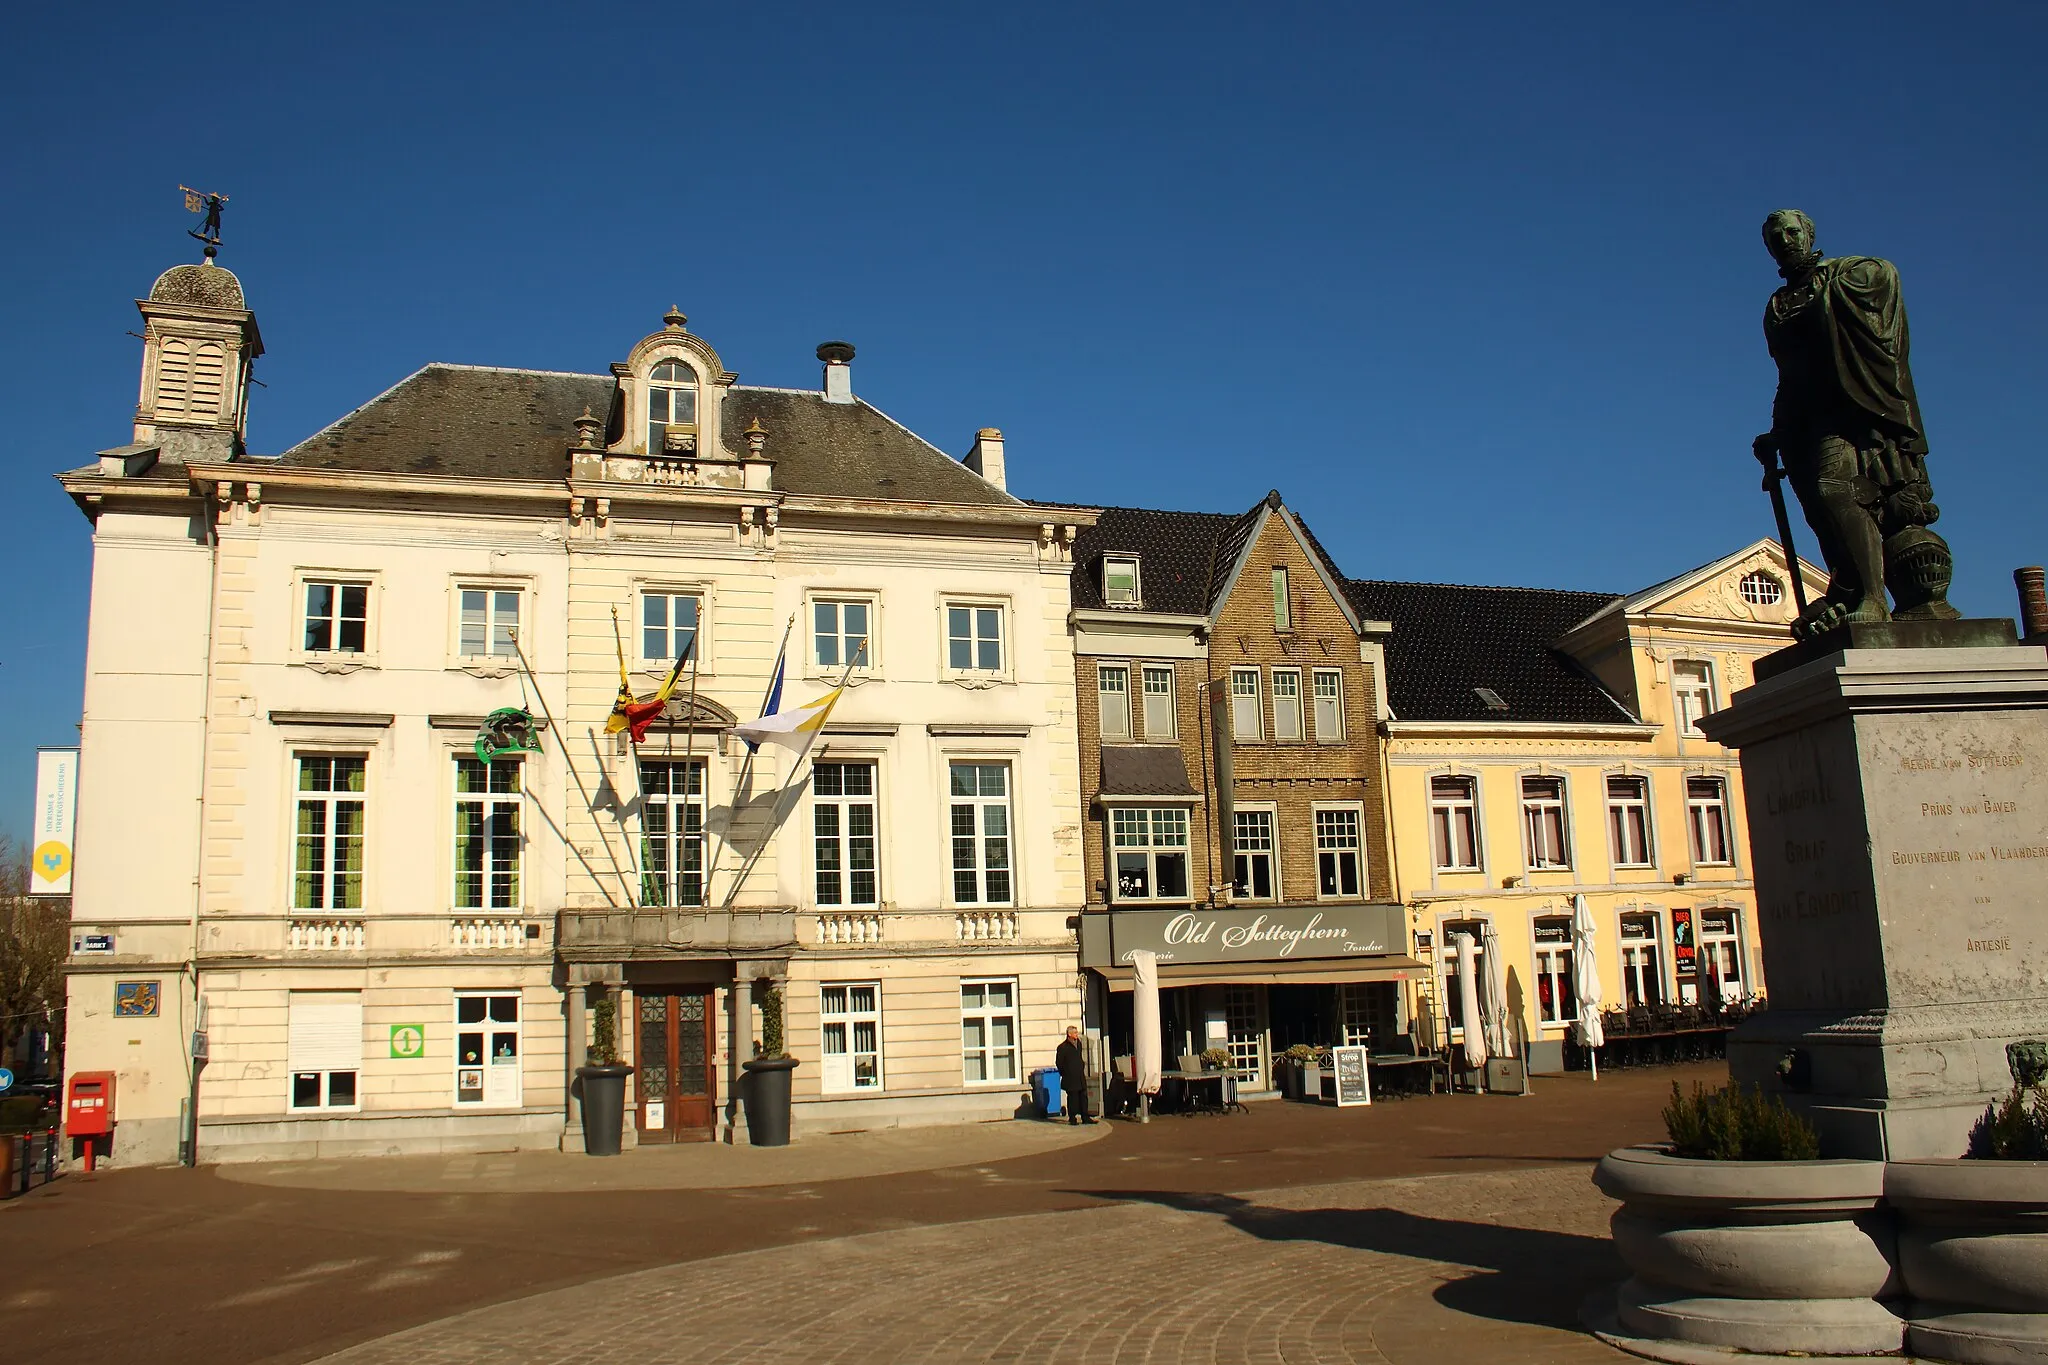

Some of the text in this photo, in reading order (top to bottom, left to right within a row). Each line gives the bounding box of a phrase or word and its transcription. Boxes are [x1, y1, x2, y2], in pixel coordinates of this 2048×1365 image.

[1983, 800, 2017, 814] GAVER
[46, 801, 54, 833] TOERISME
[1892, 850, 1961, 865] GOUVERNEUR
[1967, 851, 1986, 861] VAN
[1675, 911, 1690, 922] BIER
[1164, 912, 1350, 957] Old Sotteghem
[1343, 940, 1383, 952] Fondue
